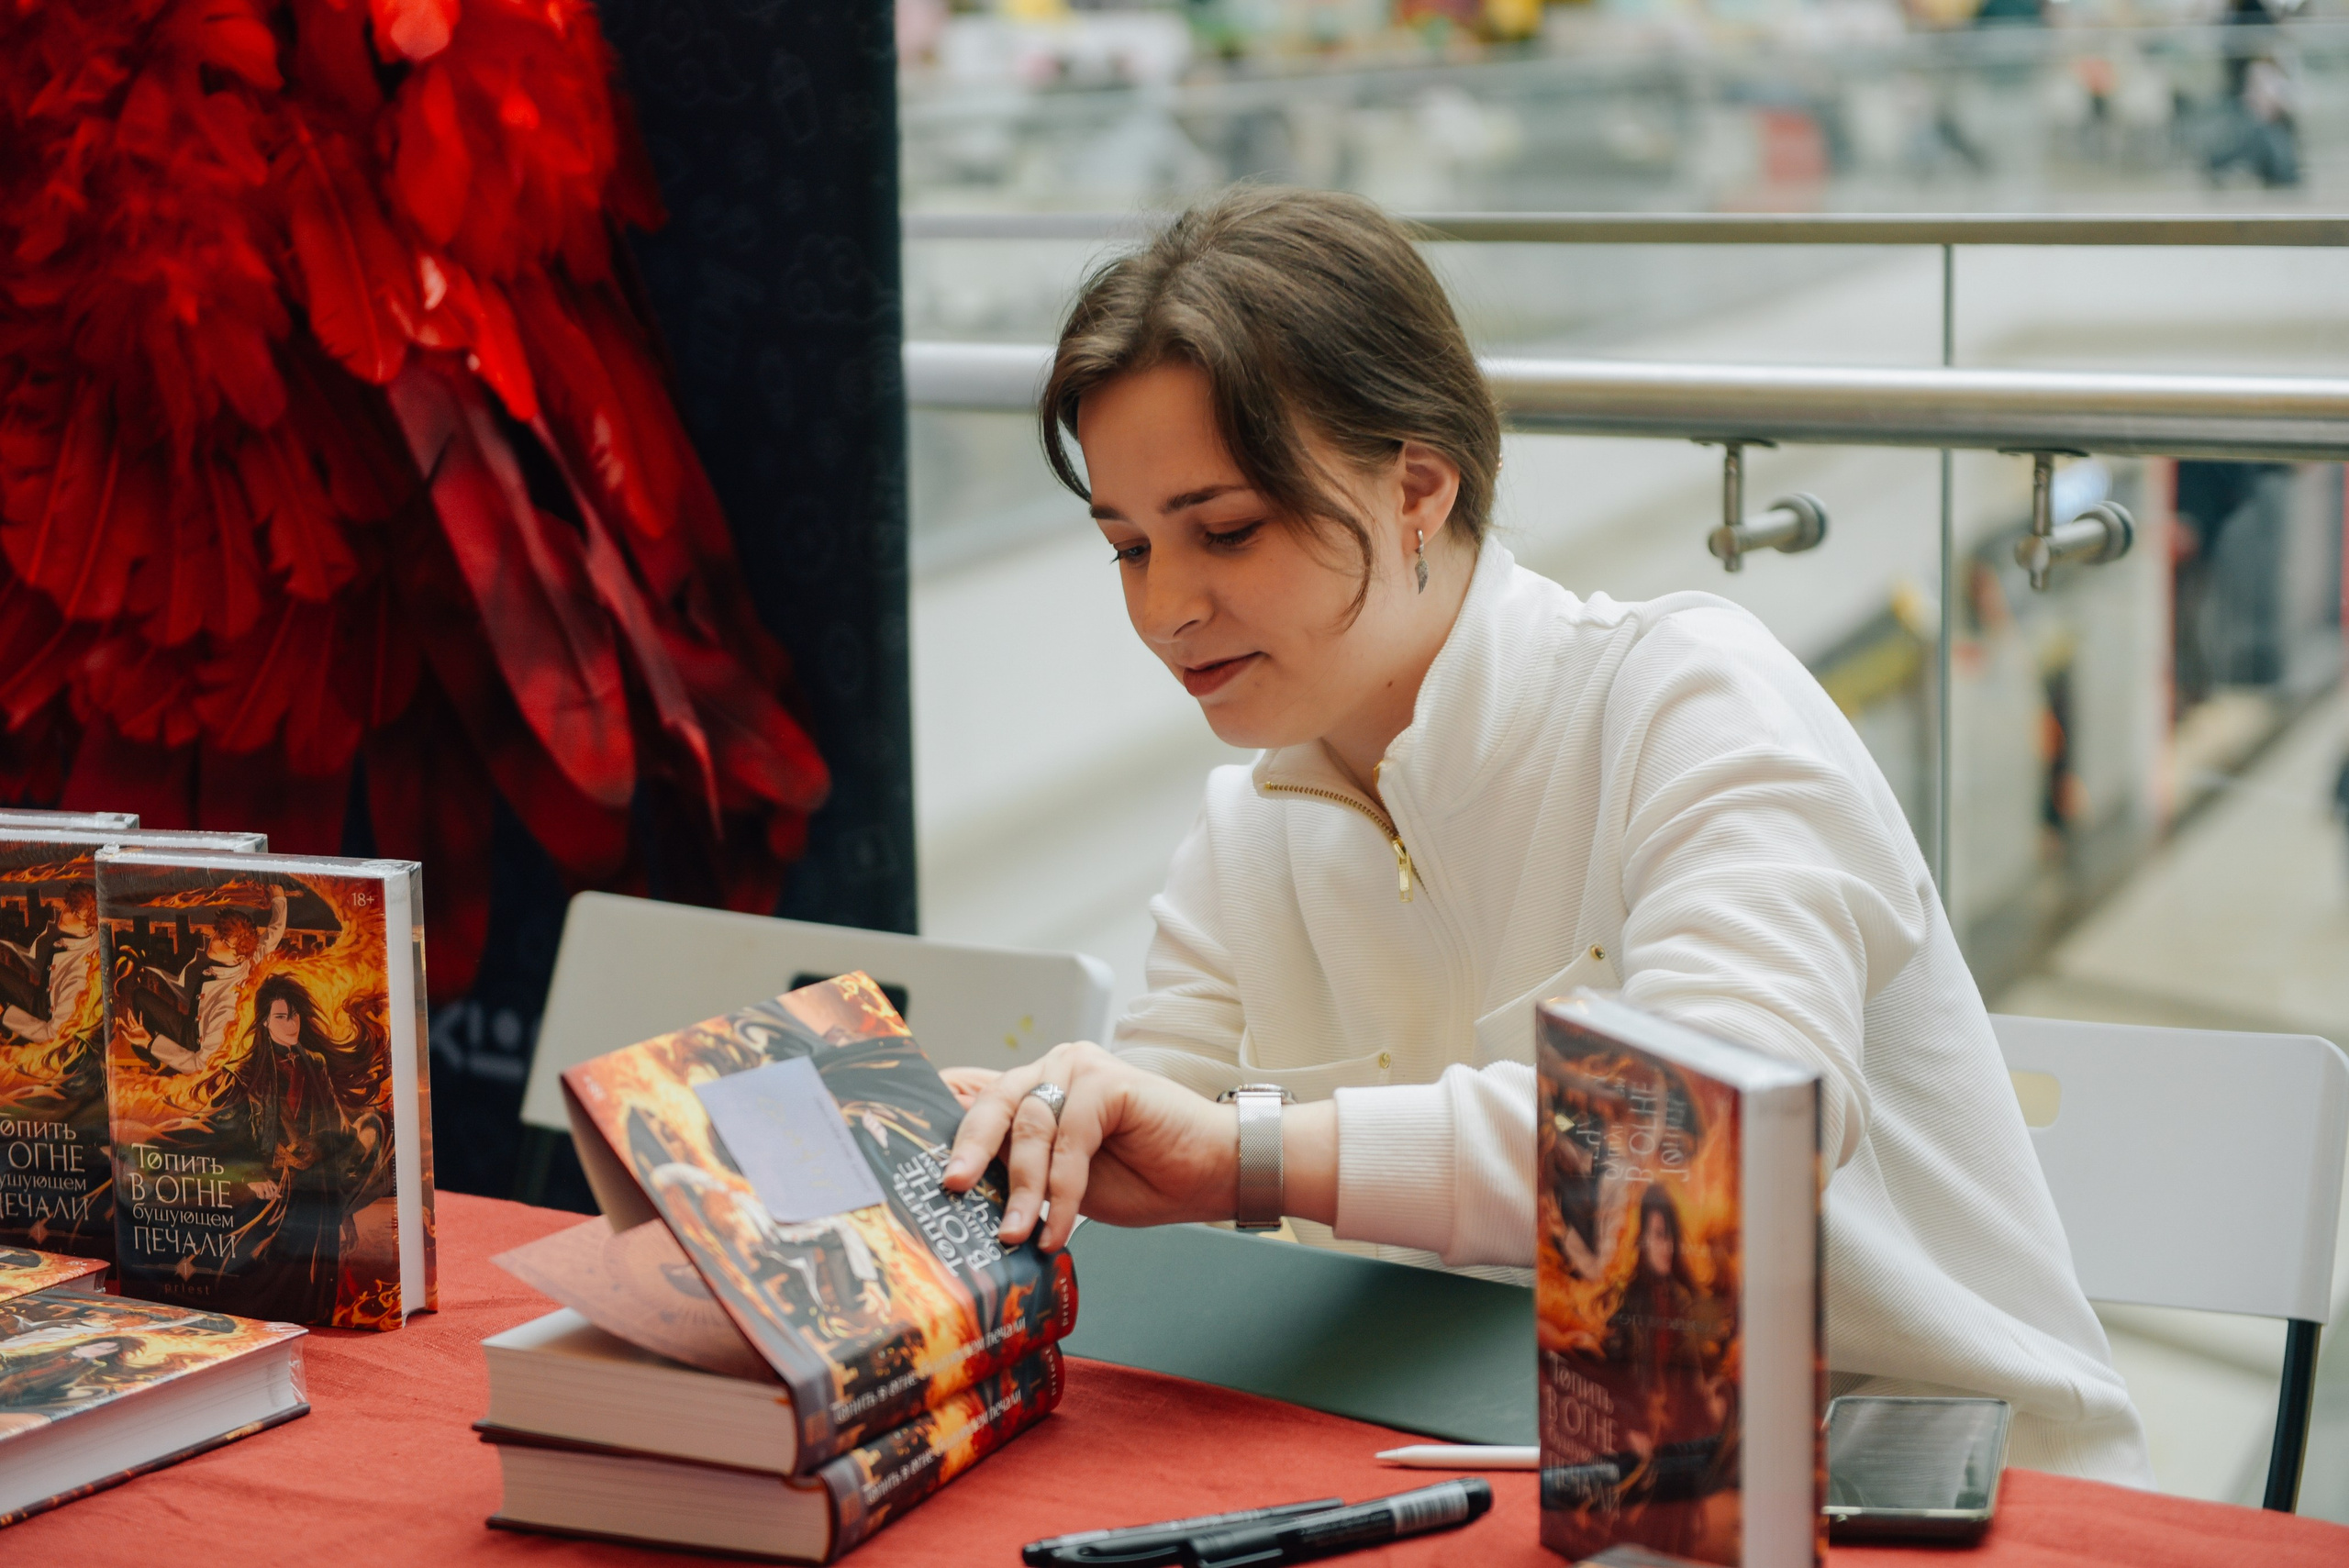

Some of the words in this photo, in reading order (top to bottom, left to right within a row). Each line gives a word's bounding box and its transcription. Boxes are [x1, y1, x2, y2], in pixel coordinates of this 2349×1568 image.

[351, 892, 375, 906] 18+
[0, 1112, 76, 1140] опить
[8, 1140, 85, 1173] ОГНЕ
[131, 1143, 224, 1174] Топить
[0, 1173, 86, 1193] ушующем
[127, 1173, 145, 1201] В
[155, 1175, 232, 1208] ОГНЕ
[0, 1192, 89, 1221] ЕЧАЛИ
[896, 1156, 969, 1244] ОГНЕ
[133, 1203, 233, 1228] бушующем
[893, 1173, 963, 1277] Топить
[134, 1226, 236, 1258] ПЕЧАЛИ
[965, 1249, 992, 1272] В
[164, 1284, 210, 1296] priest
